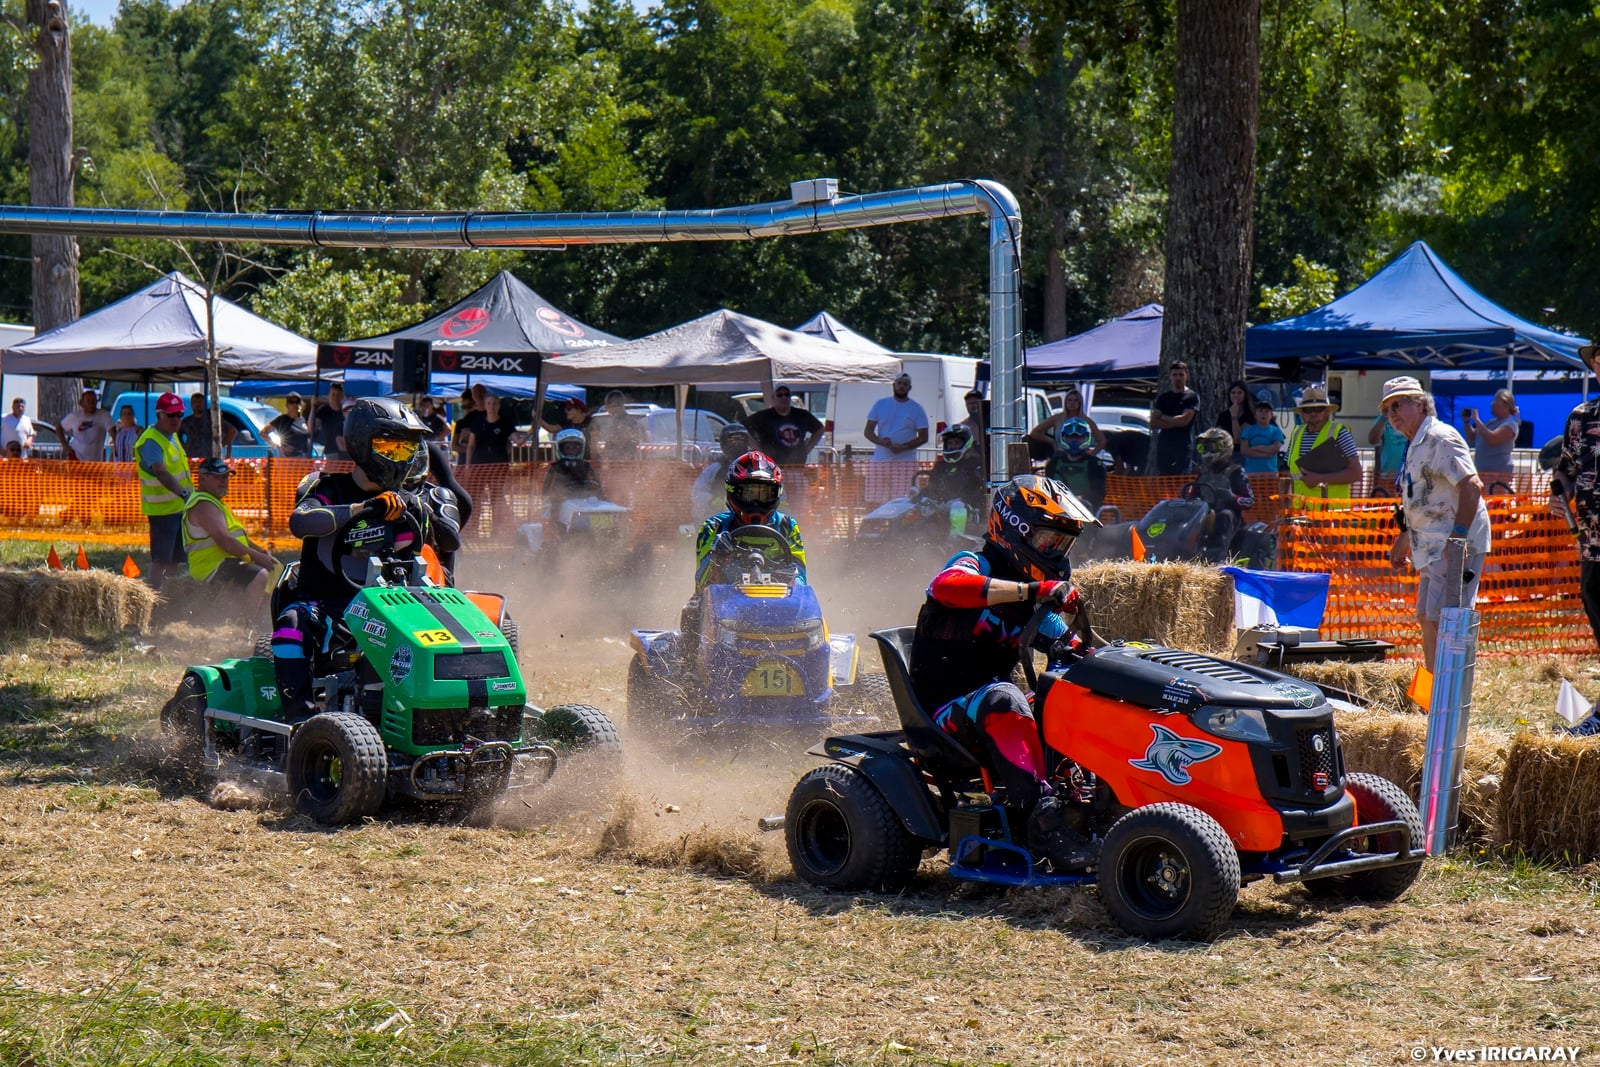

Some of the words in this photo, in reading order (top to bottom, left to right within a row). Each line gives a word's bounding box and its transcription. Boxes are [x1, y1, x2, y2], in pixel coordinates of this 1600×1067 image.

[354, 351, 394, 366] 24M
[461, 355, 523, 372] 24MX
[993, 500, 1030, 537] AMOQ
[346, 526, 385, 542] KENNY
[420, 631, 452, 643] 13
[760, 669, 785, 689] 15
